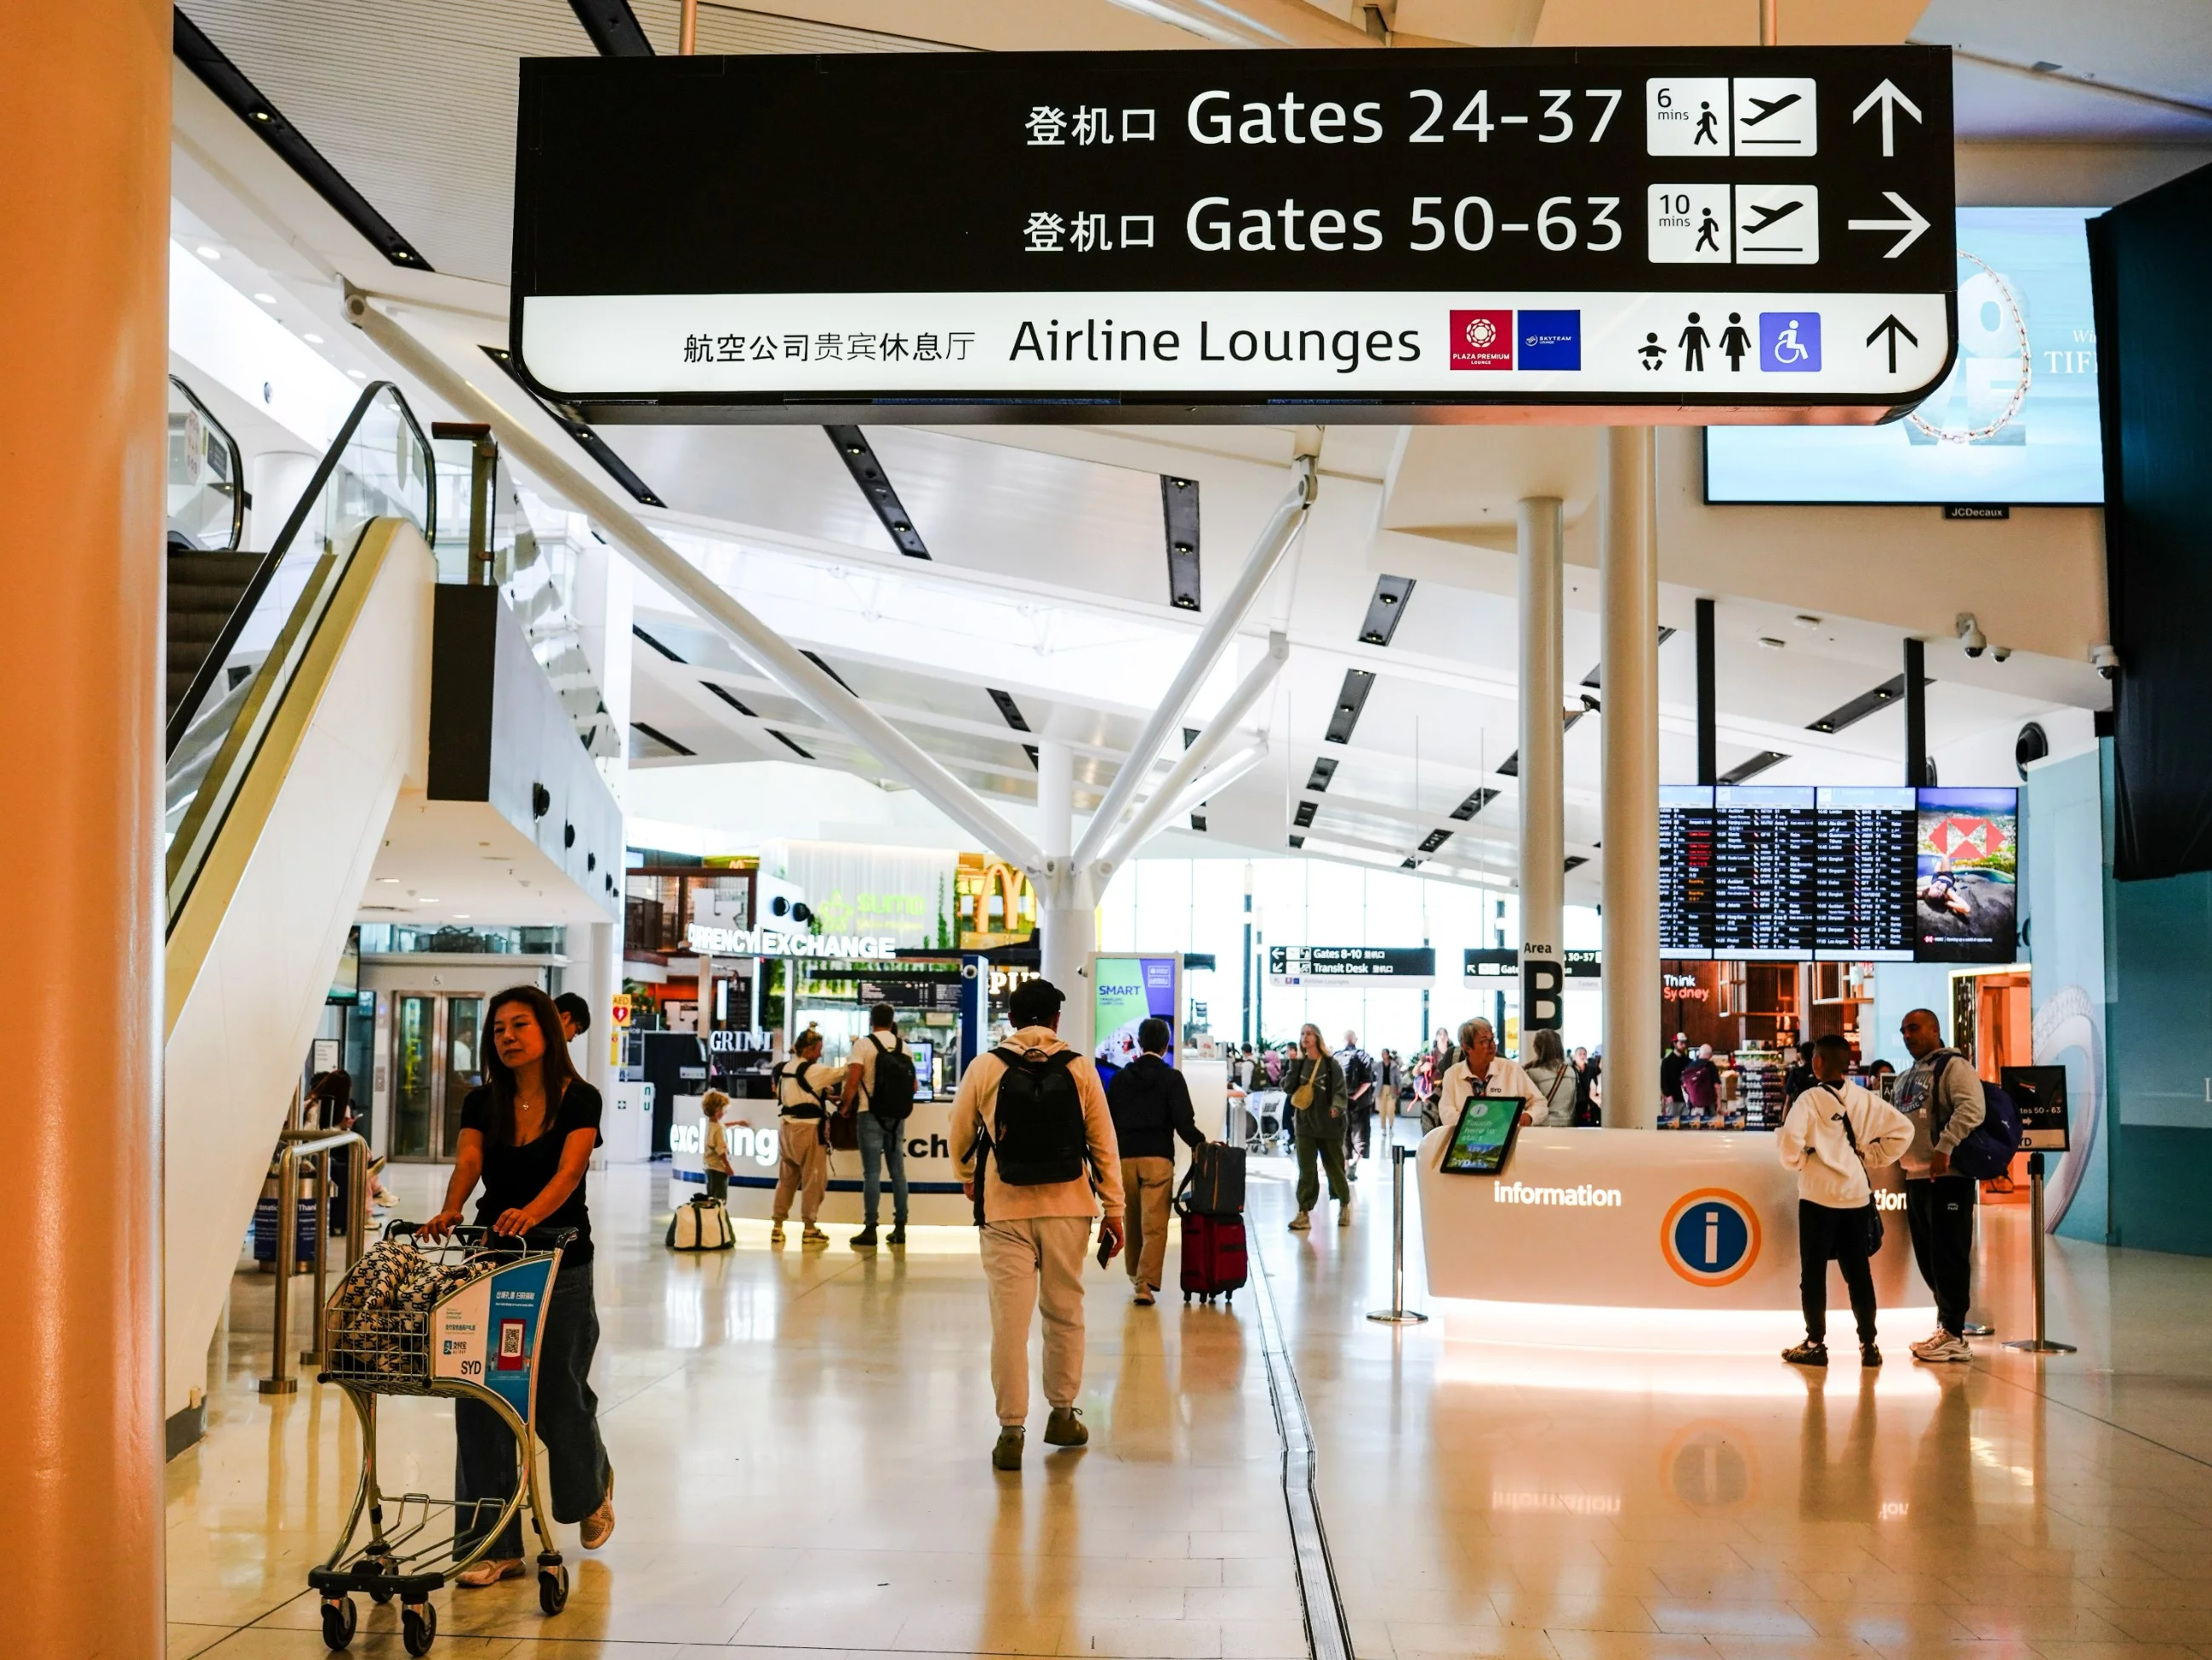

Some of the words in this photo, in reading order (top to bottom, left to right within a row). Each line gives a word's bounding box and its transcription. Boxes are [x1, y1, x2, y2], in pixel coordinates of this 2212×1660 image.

[1657, 88, 1672, 108] 6
[1025, 105, 1155, 146] 登机口
[1189, 89, 1383, 145] Gates
[1409, 88, 1622, 144] 24-37
[1657, 109, 1689, 121] mins
[1660, 194, 1690, 214] 10
[1023, 210, 1154, 253] 登机口
[1186, 196, 1383, 252] Gates
[1410, 196, 1622, 252] 50-63
[1659, 215, 1690, 227] mins
[683, 332, 976, 363] 航空公司贵宾休息厅
[1010, 318, 1180, 362] Airline
[1200, 321, 1421, 374] Lounges
[2044, 351, 2099, 374] TIF
[1952, 507, 2003, 517] JCDecaux
[762, 931, 896, 960] EXCHANGE
[1524, 942, 1552, 954] Area
[1314, 948, 1340, 959] Gates
[1340, 949, 1362, 959] 8-10
[1568, 952, 1595, 961] 30-37
[1314, 962, 1345, 973] Transit
[1345, 963, 1369, 973] Desk
[1663, 974, 1696, 987] Think
[1098, 985, 1141, 995] SMART
[1524, 961, 1563, 1031] B
[1663, 987, 1710, 1001] Sydney
[1494, 1179, 1622, 1206] information
[461, 1360, 482, 1375] SYD
